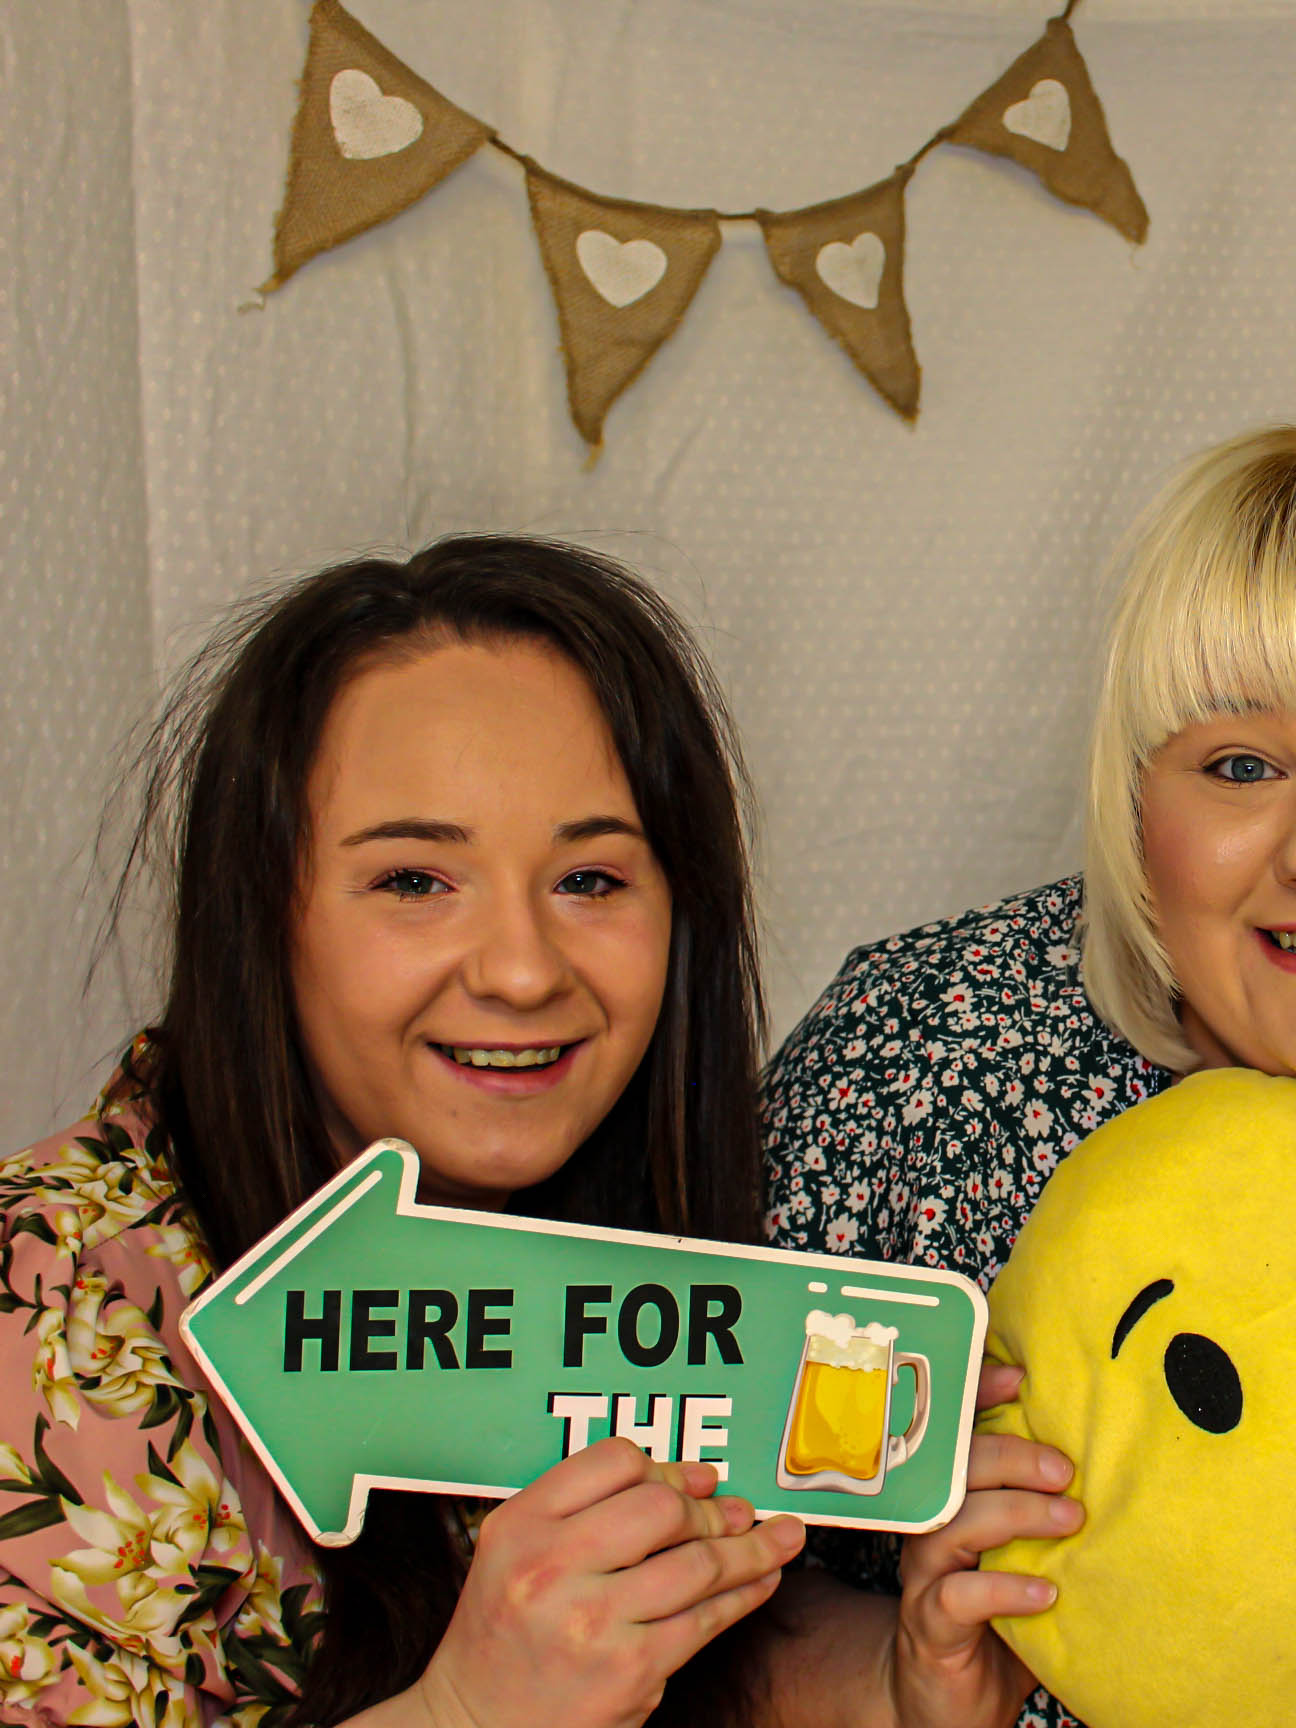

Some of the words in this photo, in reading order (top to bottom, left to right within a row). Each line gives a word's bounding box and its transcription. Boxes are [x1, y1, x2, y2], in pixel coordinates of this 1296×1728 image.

[284, 1289, 514, 1372] HERE
[562, 1284, 744, 1368] FOR
[547, 1392, 732, 1482] THE
